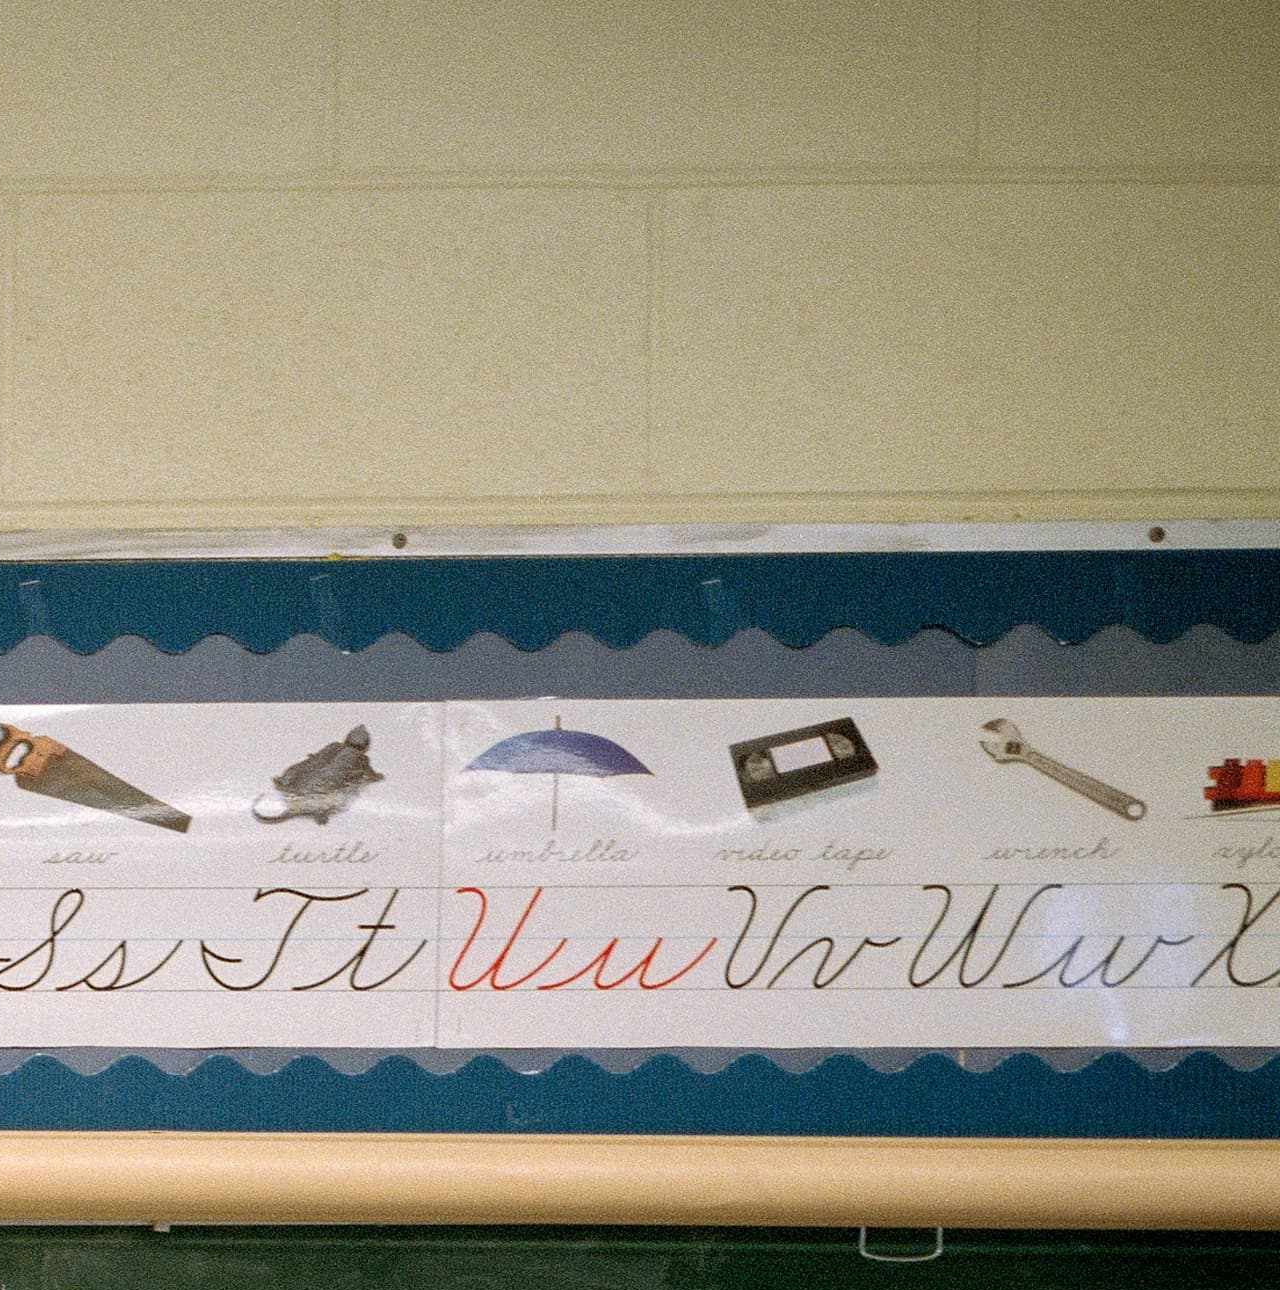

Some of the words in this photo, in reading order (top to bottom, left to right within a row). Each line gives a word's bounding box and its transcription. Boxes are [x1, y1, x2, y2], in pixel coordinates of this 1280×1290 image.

[42, 846, 121, 864] saw
[268, 839, 384, 864] turtle
[473, 836, 640, 863] umbrella
[714, 839, 801, 862] video
[815, 839, 893, 869] tape
[982, 837, 1122, 862] wrench
